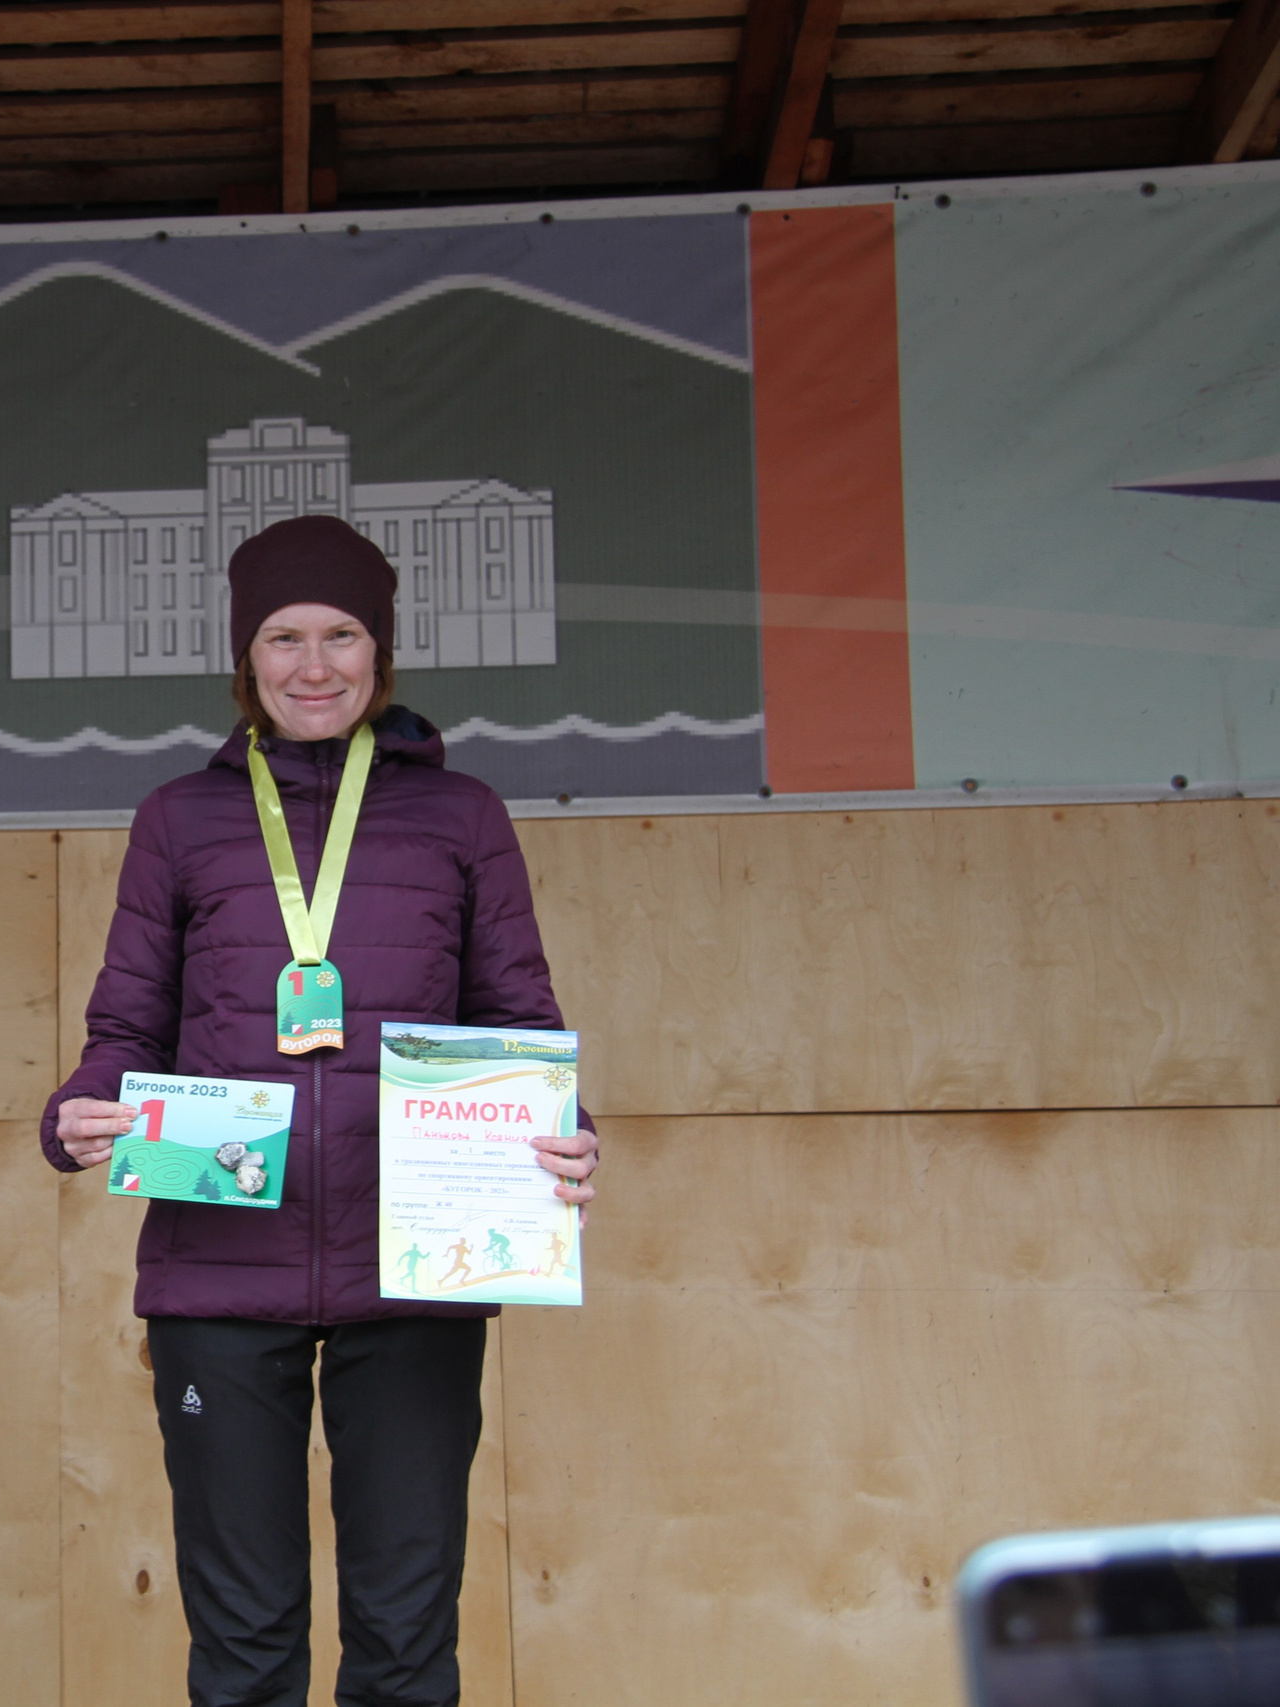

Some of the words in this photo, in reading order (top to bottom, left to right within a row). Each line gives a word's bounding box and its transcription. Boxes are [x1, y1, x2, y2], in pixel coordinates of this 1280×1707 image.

[288, 971, 303, 996] 1
[310, 1018, 342, 1029] 2023
[280, 1033, 342, 1050] БУГОРОК
[126, 1080, 185, 1095] Бугорок
[189, 1084, 228, 1098] 2023
[140, 1098, 165, 1142] 1
[404, 1099, 533, 1124] ГРАМОТА
